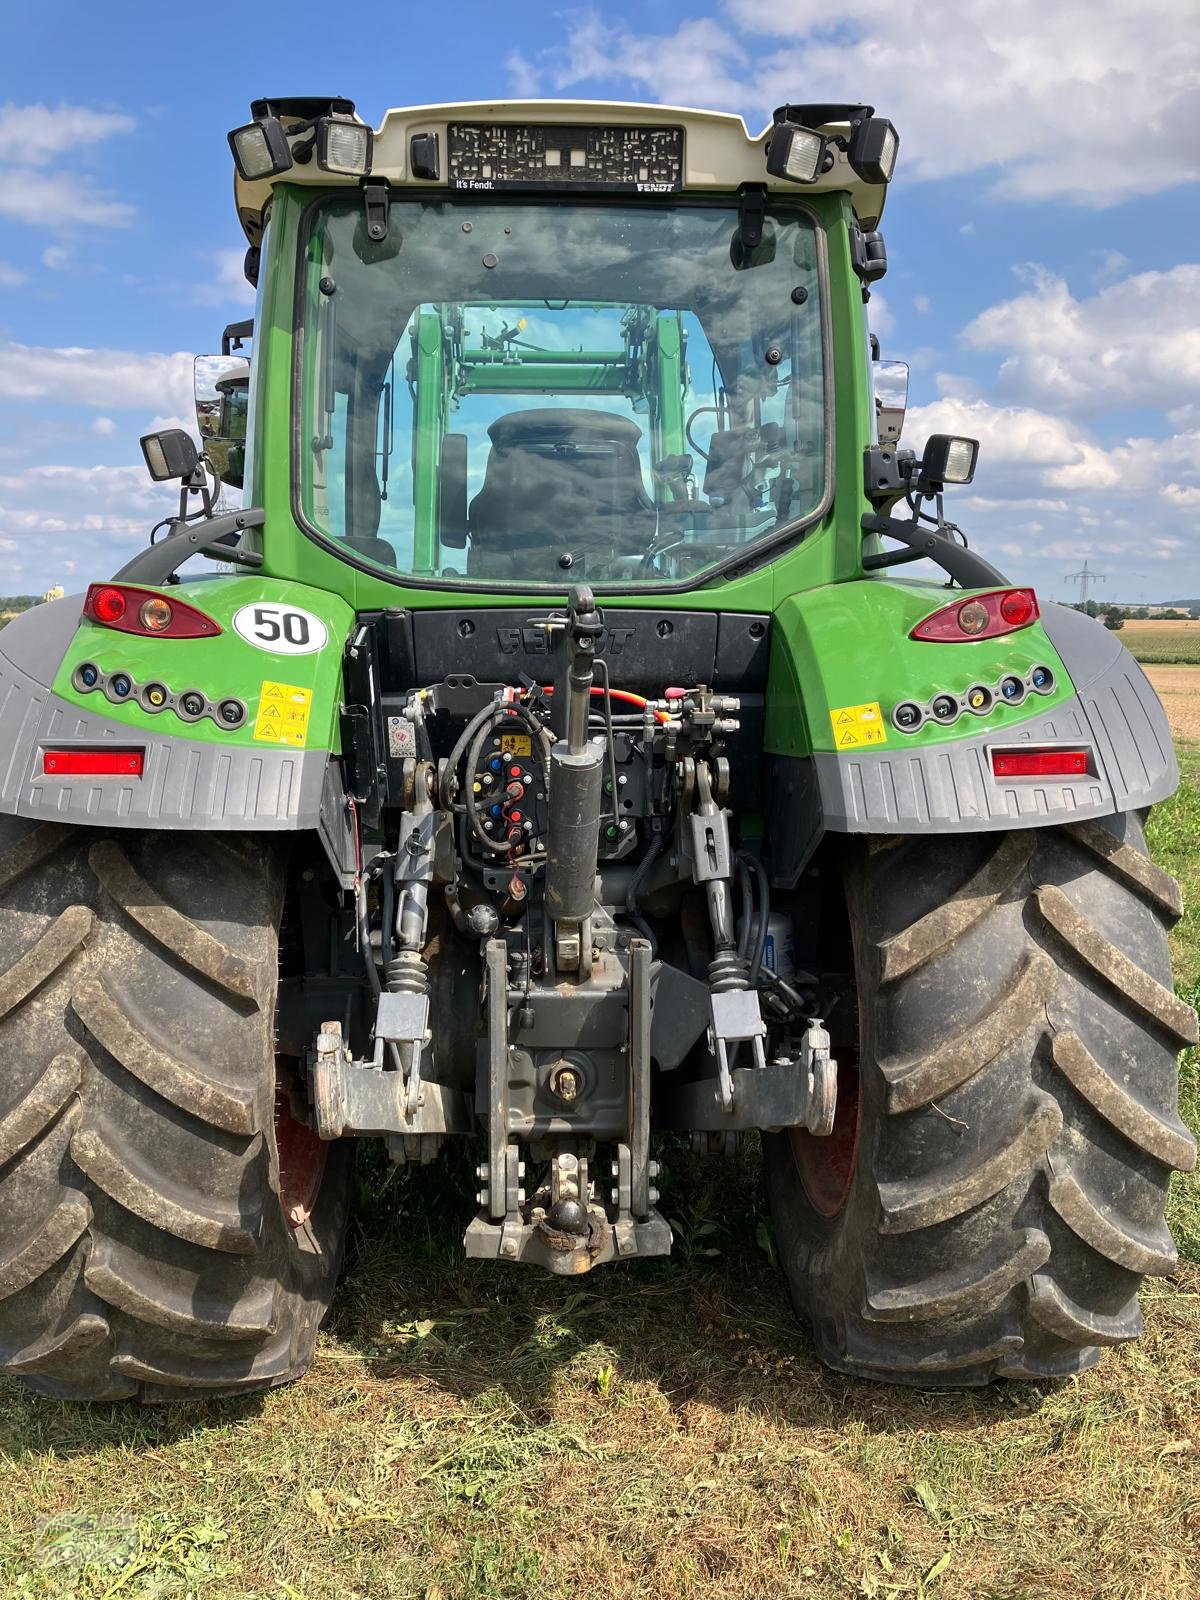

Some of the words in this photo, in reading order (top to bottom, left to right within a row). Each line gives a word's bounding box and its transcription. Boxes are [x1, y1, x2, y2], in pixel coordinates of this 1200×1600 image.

[456, 180, 468, 189] It's
[470, 180, 495, 190] Fendt.
[636, 183, 675, 192] FENDT
[254, 608, 310, 646] 50
[496, 627, 637, 655] FET
